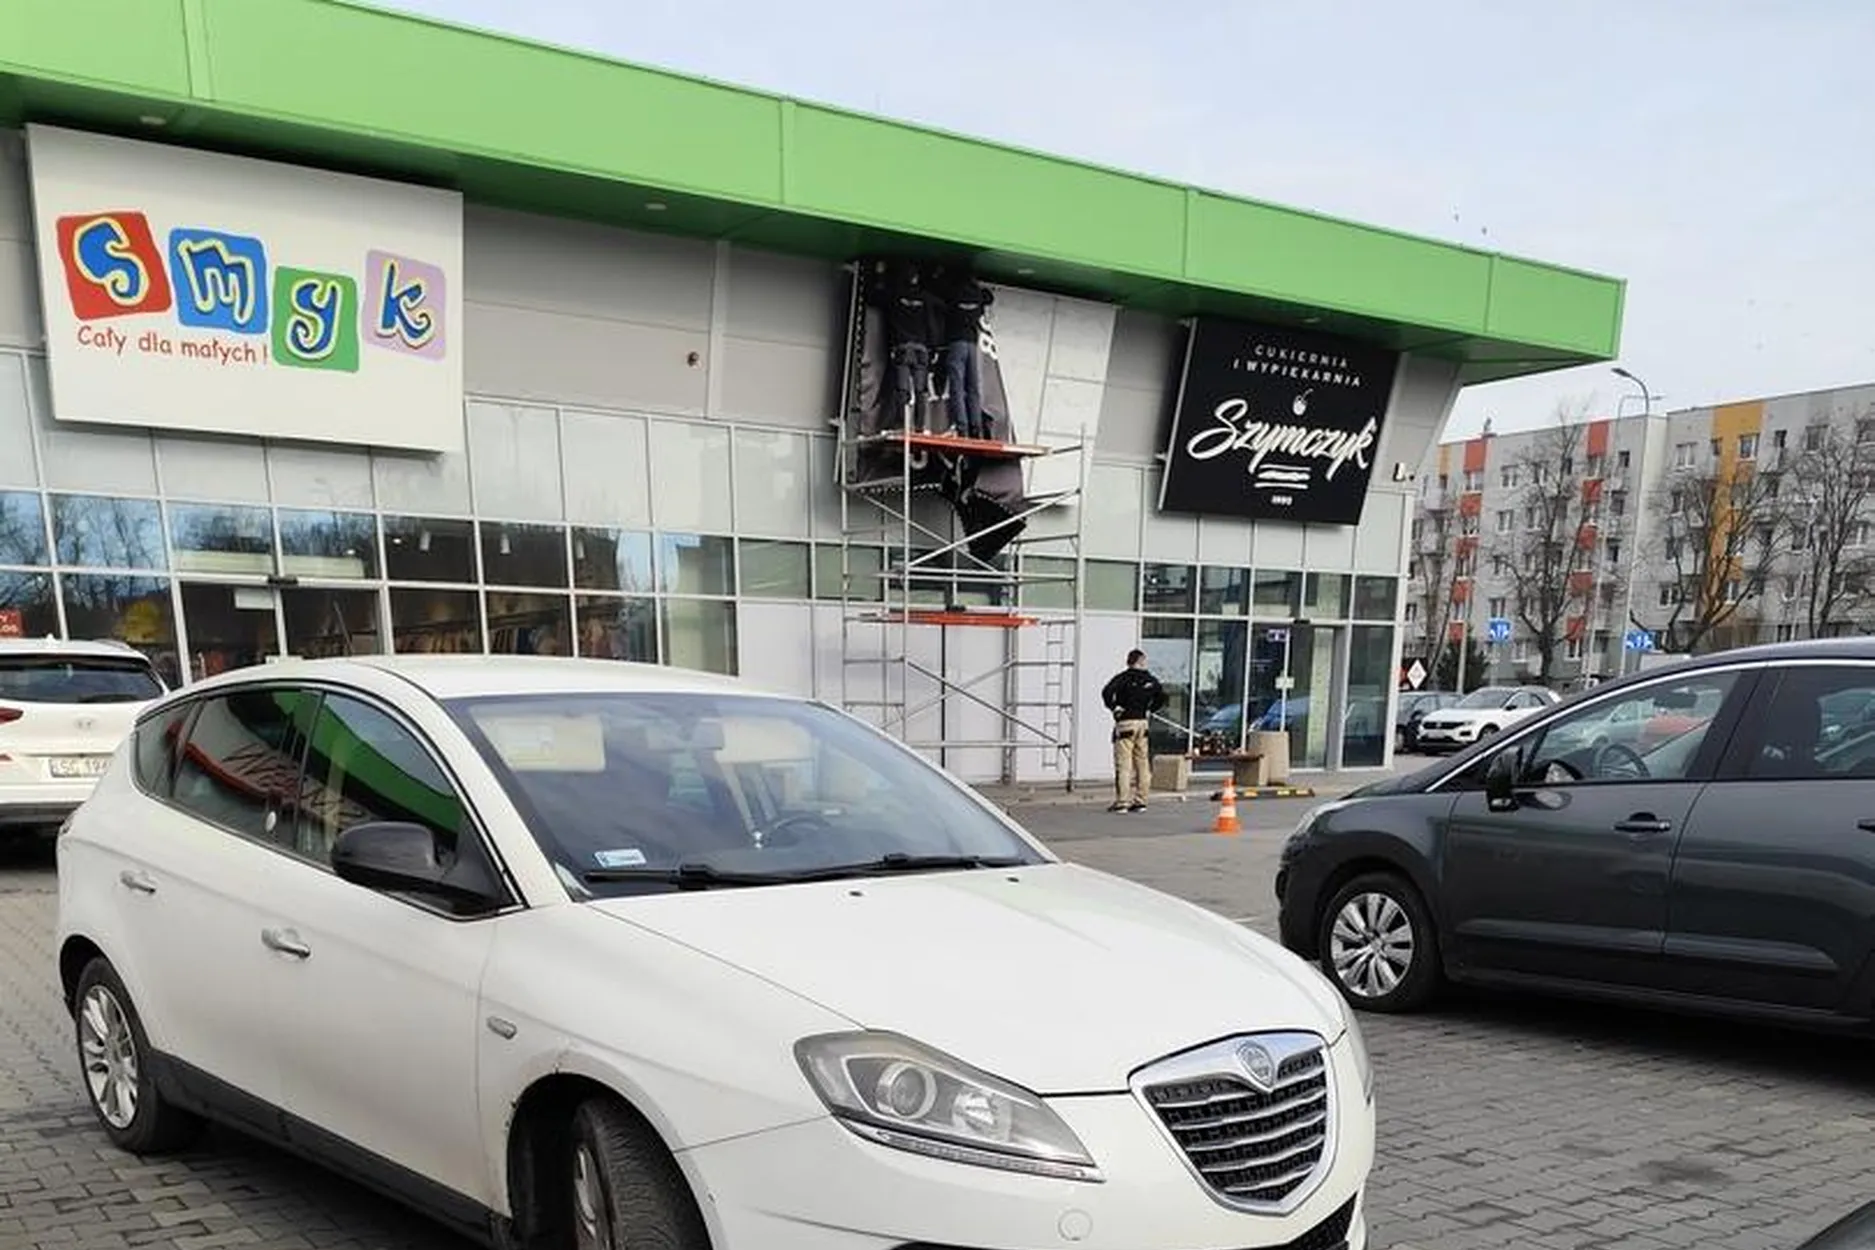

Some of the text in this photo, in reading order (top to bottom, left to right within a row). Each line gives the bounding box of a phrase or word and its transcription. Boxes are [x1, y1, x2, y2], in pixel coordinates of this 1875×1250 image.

[77, 324, 127, 356] Cały
[138, 332, 173, 356] dla
[1255, 344, 1348, 368] CUKIERNIA
[1246, 361, 1361, 387] WYPIEKARNIA
[1187, 399, 1378, 482] Szymczyk
